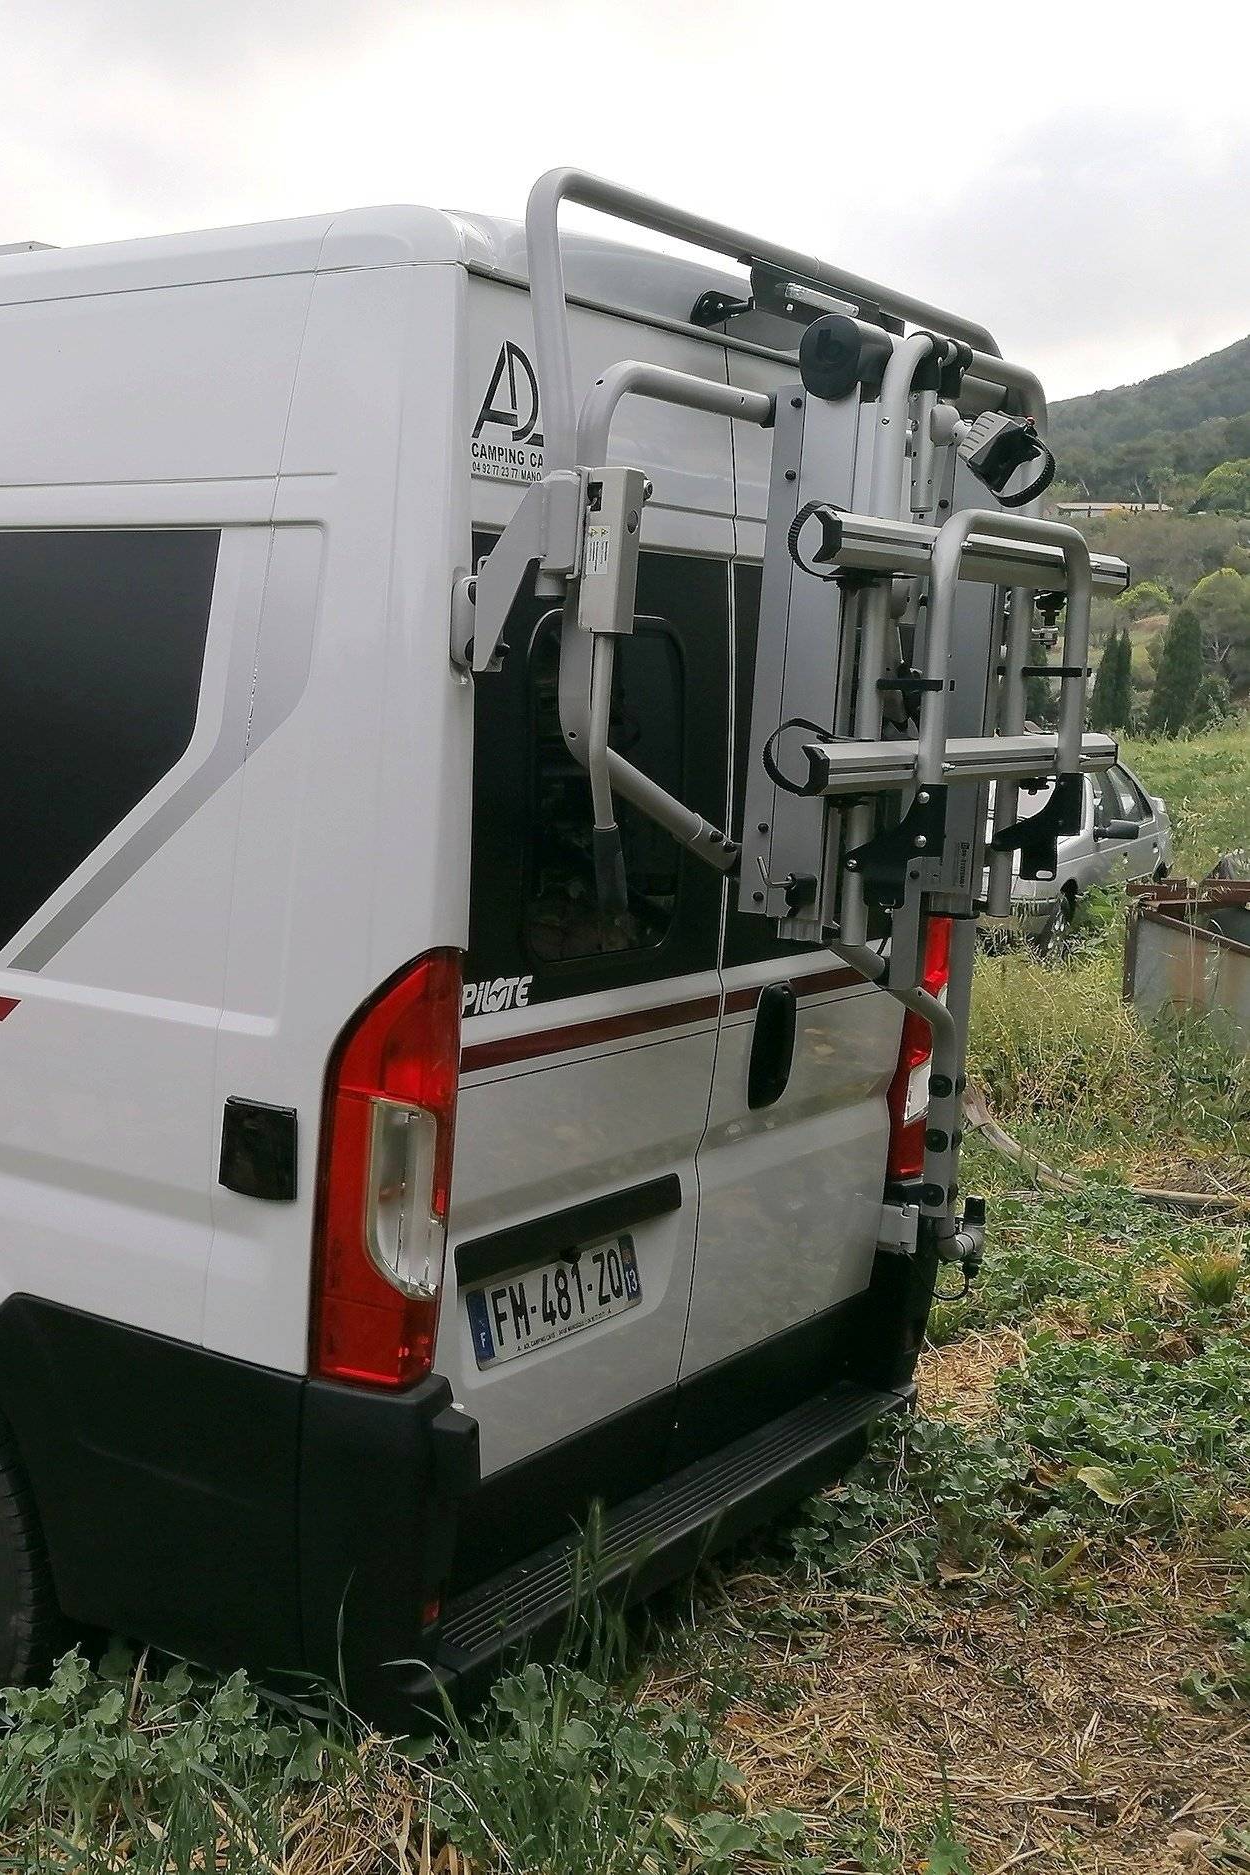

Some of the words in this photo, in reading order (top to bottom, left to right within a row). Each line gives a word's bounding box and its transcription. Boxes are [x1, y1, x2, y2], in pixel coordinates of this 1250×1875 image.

[471, 442, 525, 466] CAMPING
[472, 461, 481, 473] 04
[482, 463, 491, 475] 92
[492, 464, 500, 476] 77
[501, 466, 510, 478] 23
[511, 467, 519, 479] 77
[480, 1331, 486, 1348] F
[491, 1248, 624, 1346] FM-481-ZQ
[625, 1269, 638, 1293] 13
